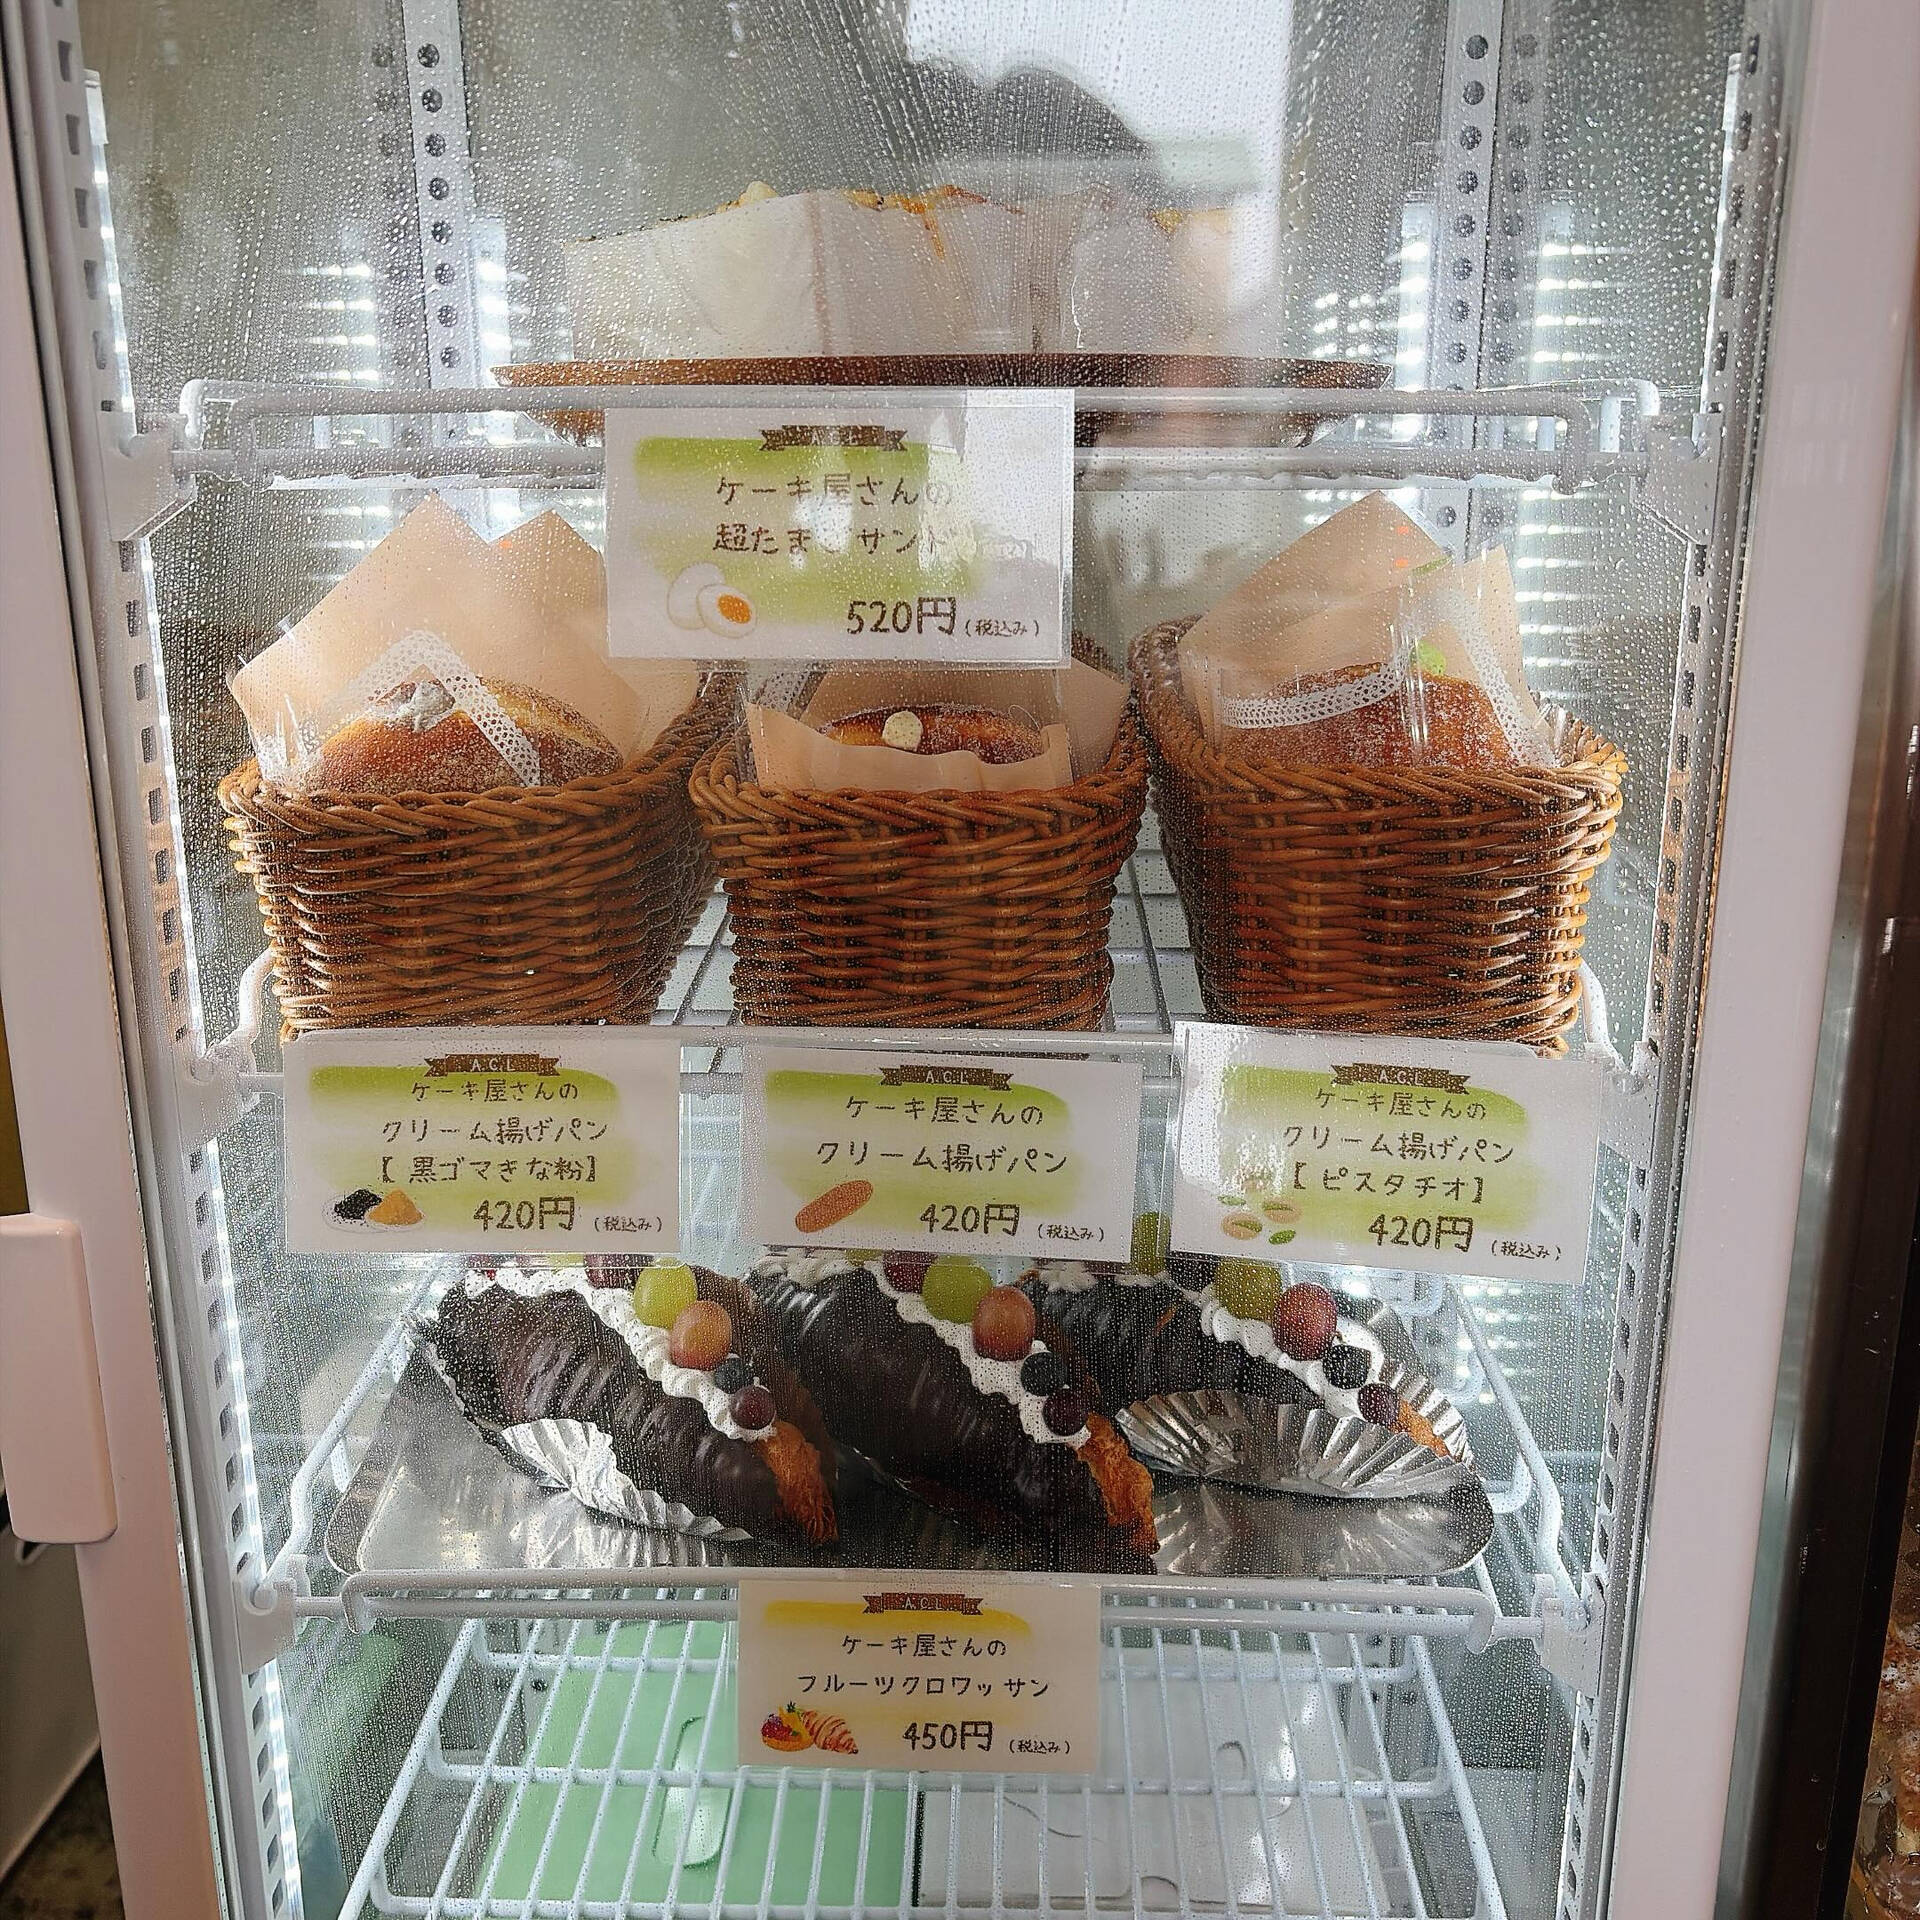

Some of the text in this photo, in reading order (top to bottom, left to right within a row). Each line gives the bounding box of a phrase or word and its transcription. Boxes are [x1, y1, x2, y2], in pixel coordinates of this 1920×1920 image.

[847, 596, 958, 636] 520円
[411, 1079, 579, 1103] ケーキ屋さんの
[1315, 1087, 1487, 1121] ケーキ屋さんの
[846, 1095, 1044, 1125] ケーキ屋さんの
[382, 1116, 608, 1145] クリーム揚げパン
[1283, 1125, 1515, 1164] クリーム揚げパン
[816, 1140, 1068, 1174] クリーム揚げパン
[472, 1195, 577, 1232] 420円
[918, 1202, 1021, 1237] 420円
[1368, 1213, 1474, 1252] 420円
[840, 1633, 1007, 1657] ケーキ屋さんの
[797, 1673, 1049, 1698] フルーツクロワッサン
[902, 1720, 994, 1752] 450円
